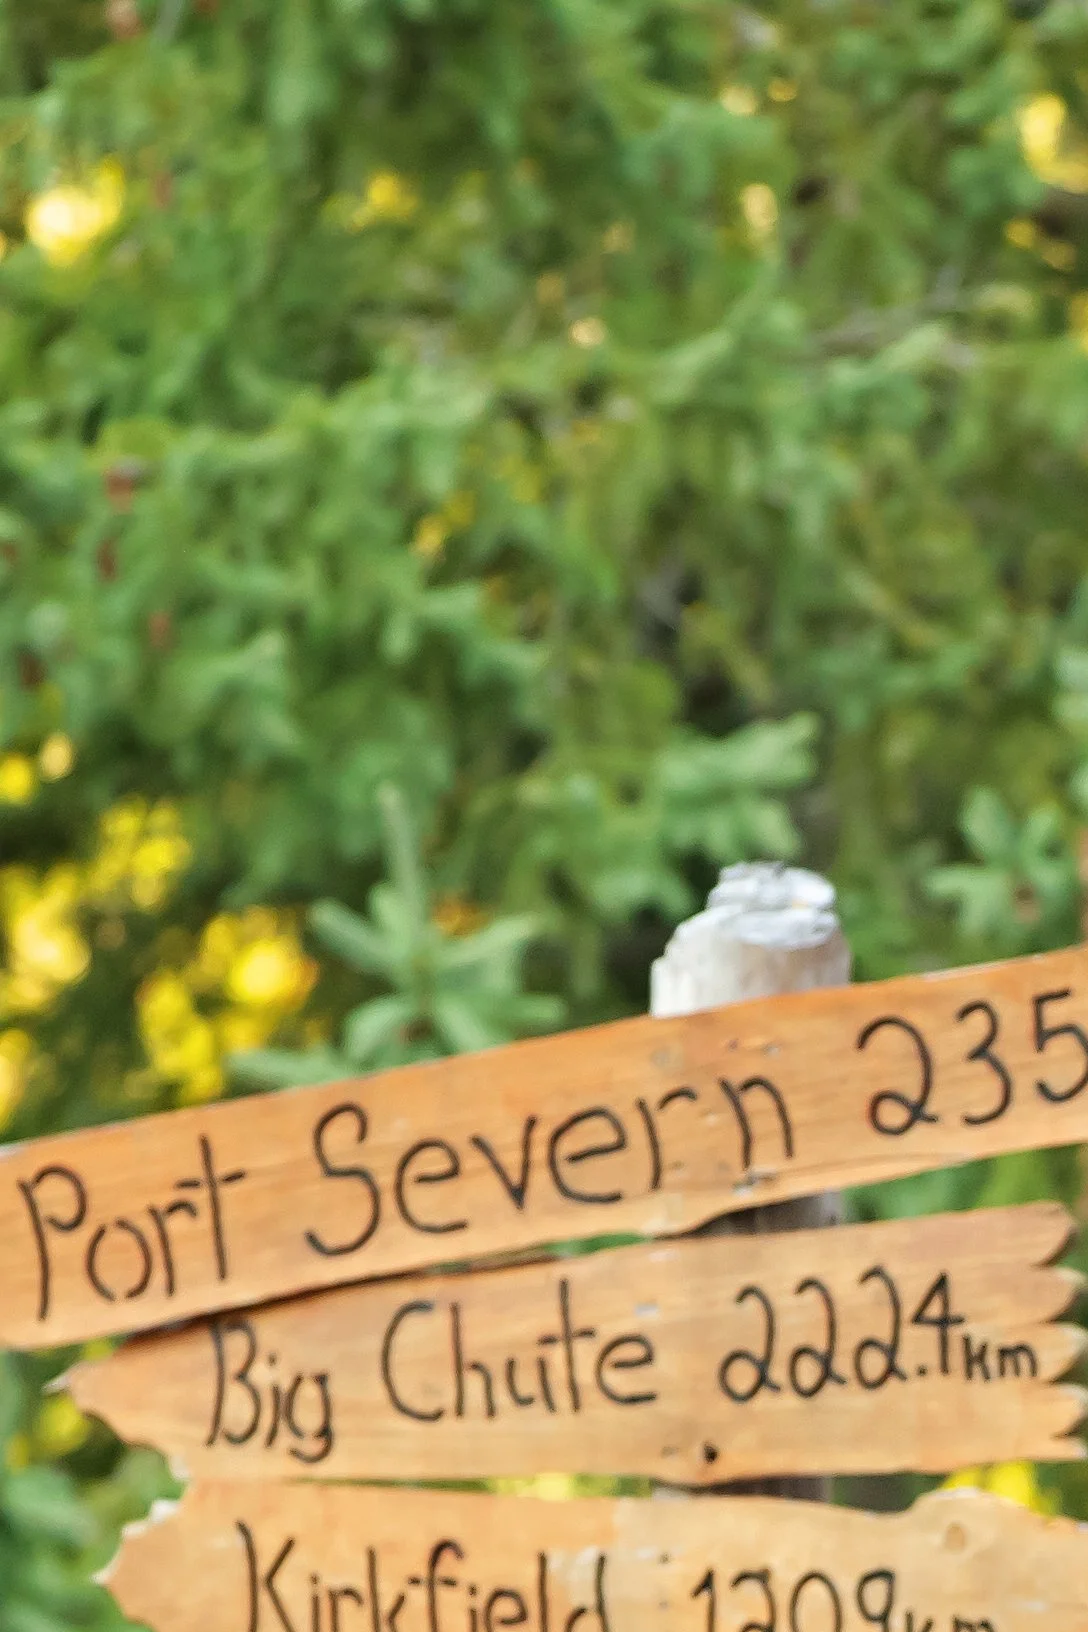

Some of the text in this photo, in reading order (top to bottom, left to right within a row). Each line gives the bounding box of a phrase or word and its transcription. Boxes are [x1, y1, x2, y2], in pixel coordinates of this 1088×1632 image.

[18, 1132, 248, 1322] Port
[304, 1073, 794, 1256] Severn
[205, 1317, 334, 1463] Big
[380, 1277, 658, 1423] Chute
